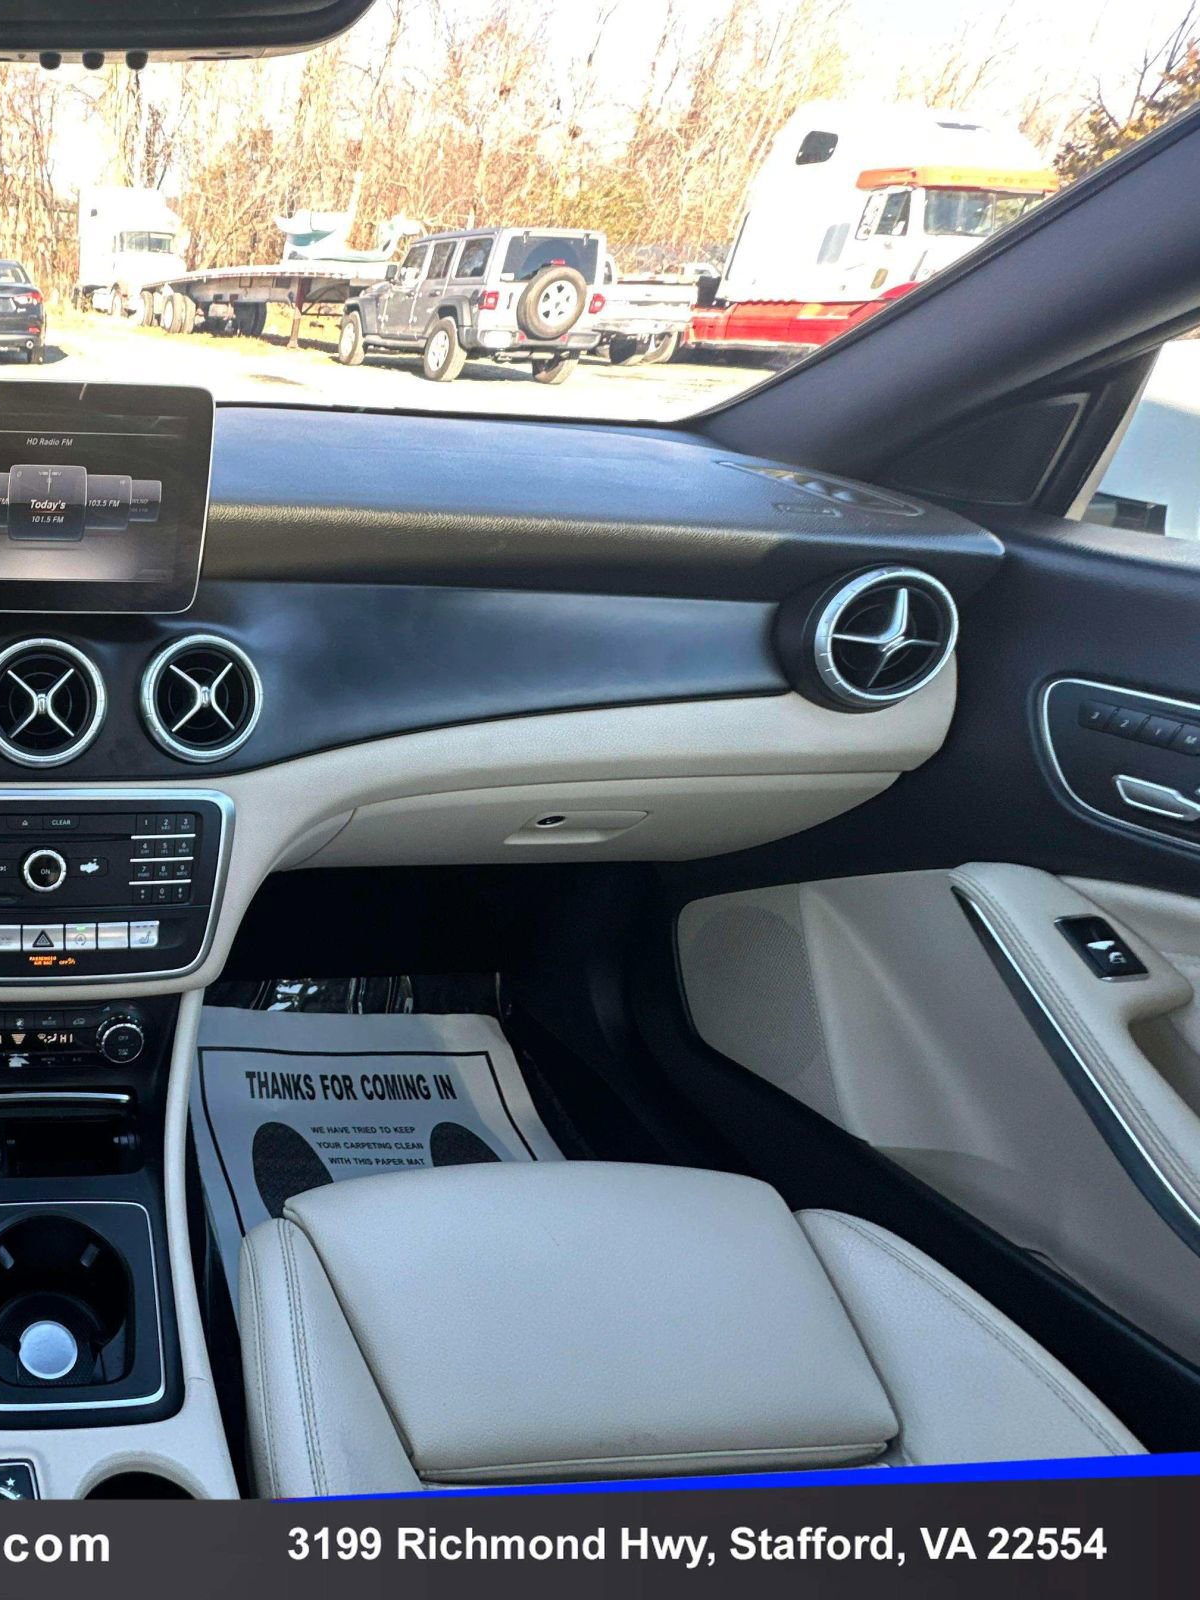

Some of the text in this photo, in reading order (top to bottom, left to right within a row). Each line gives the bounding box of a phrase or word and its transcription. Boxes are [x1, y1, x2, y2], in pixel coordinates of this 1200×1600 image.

[26, 438, 73, 447] HD Radio FM
[30, 499, 66, 511] Today's
[88, 499, 120, 508] 103.5 FM
[32, 515, 64, 524] 101.5 FM
[245, 1071, 457, 1101] THANKS FOR COMING IN
[311, 1126, 416, 1134] WE HAVE TRIED TO KEEP
[343, 1142, 392, 1150] CARPETING
[394, 1142, 424, 1150] CLEAN
[328, 1157, 425, 1166] WITH THIS PAPER MAT
